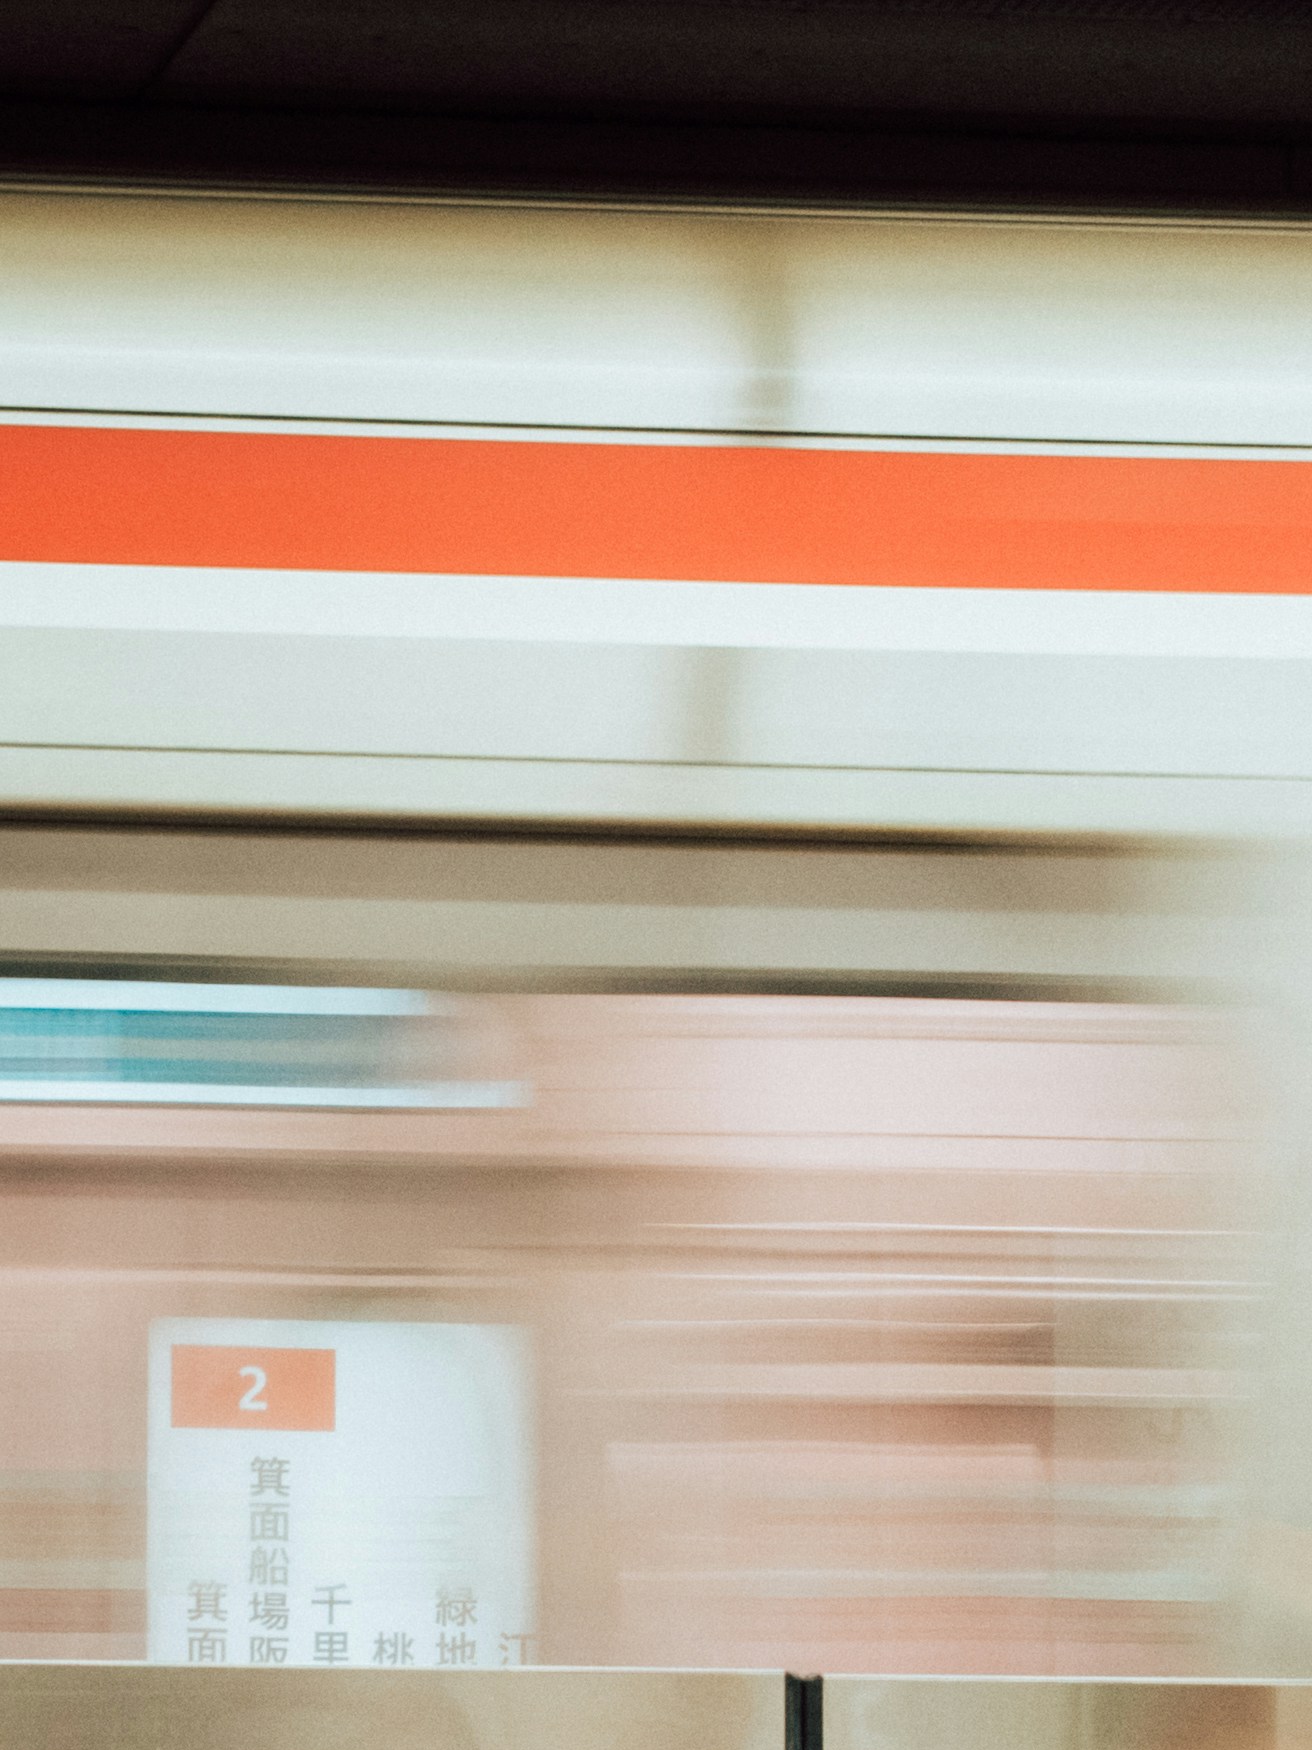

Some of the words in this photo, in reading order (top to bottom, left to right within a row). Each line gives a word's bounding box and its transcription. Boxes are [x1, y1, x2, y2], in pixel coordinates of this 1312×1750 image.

[239, 1365, 268, 1411] 2
[249, 1456, 290, 1664] 箕面船場阪
[311, 1584, 352, 1664] 千里
